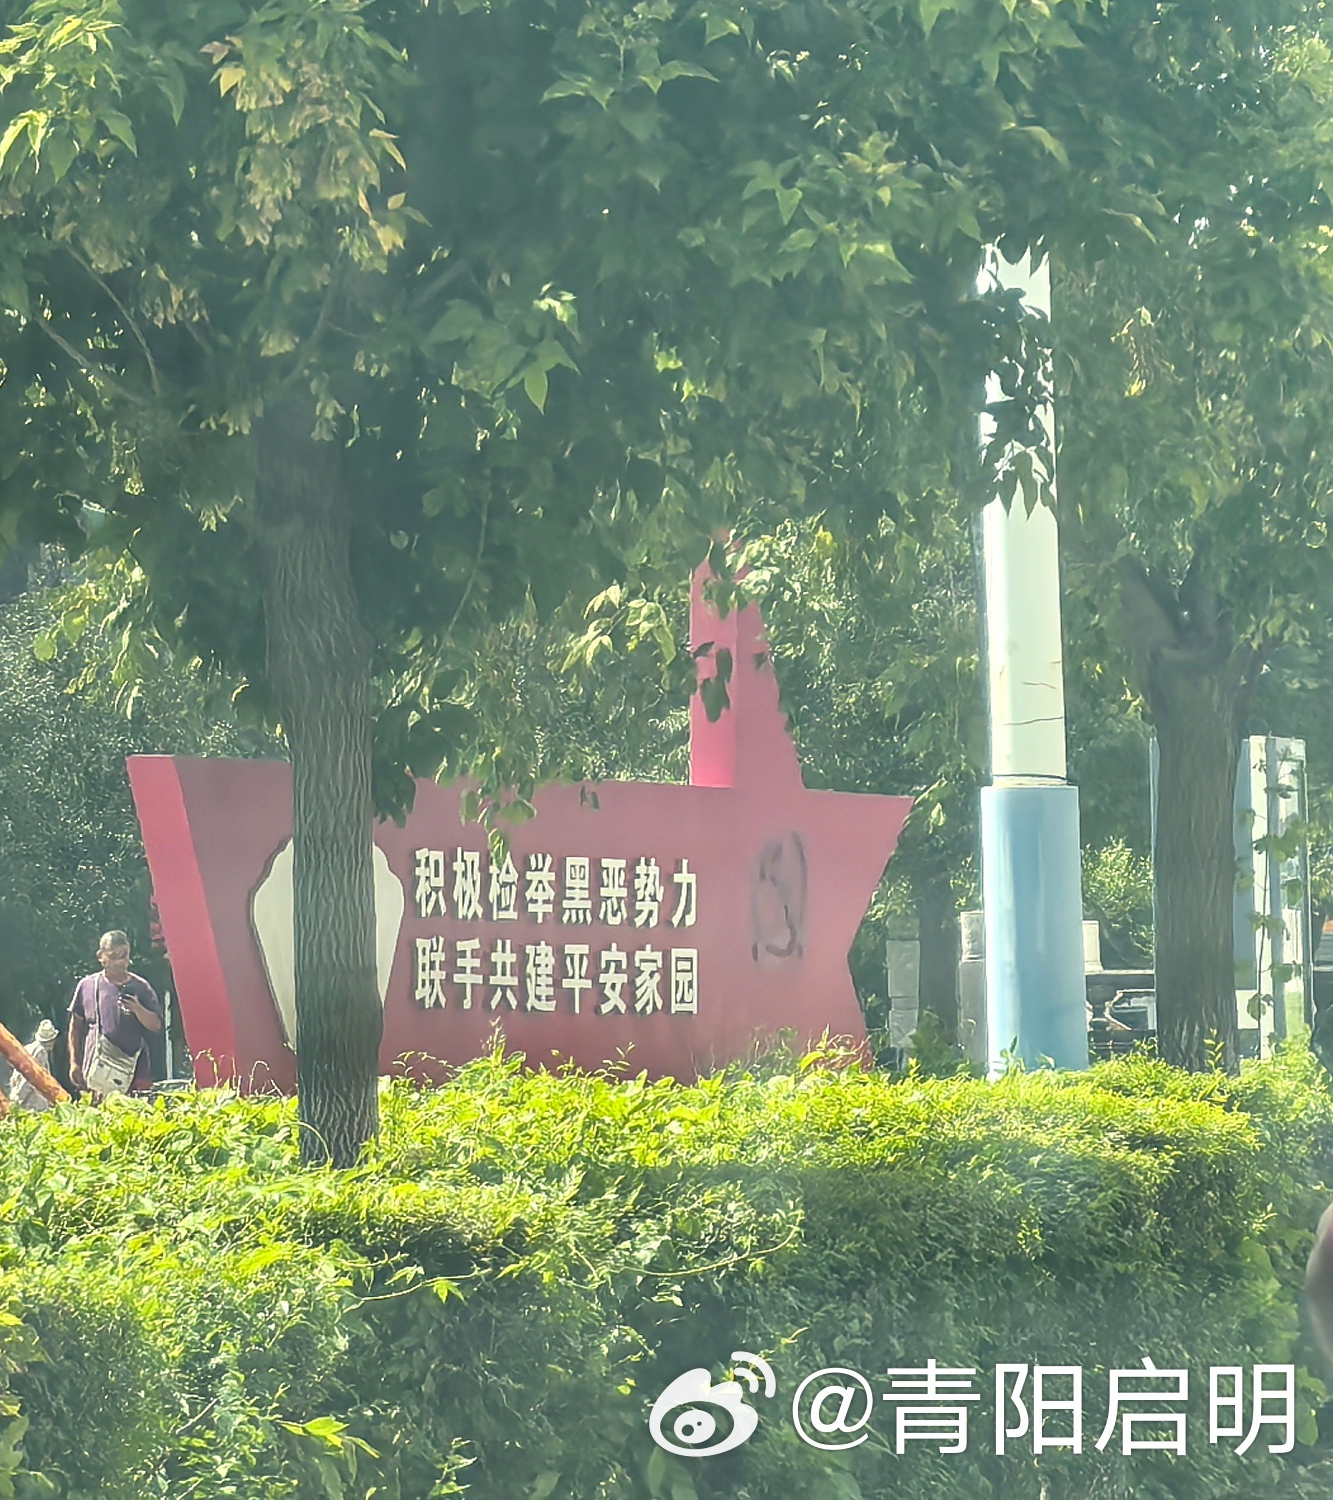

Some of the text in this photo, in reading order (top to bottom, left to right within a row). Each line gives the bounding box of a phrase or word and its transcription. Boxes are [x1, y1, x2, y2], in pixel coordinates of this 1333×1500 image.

[415, 847, 697, 928] 积极检举黑恶势力
[415, 936, 698, 1015] 联手共建平安家园
